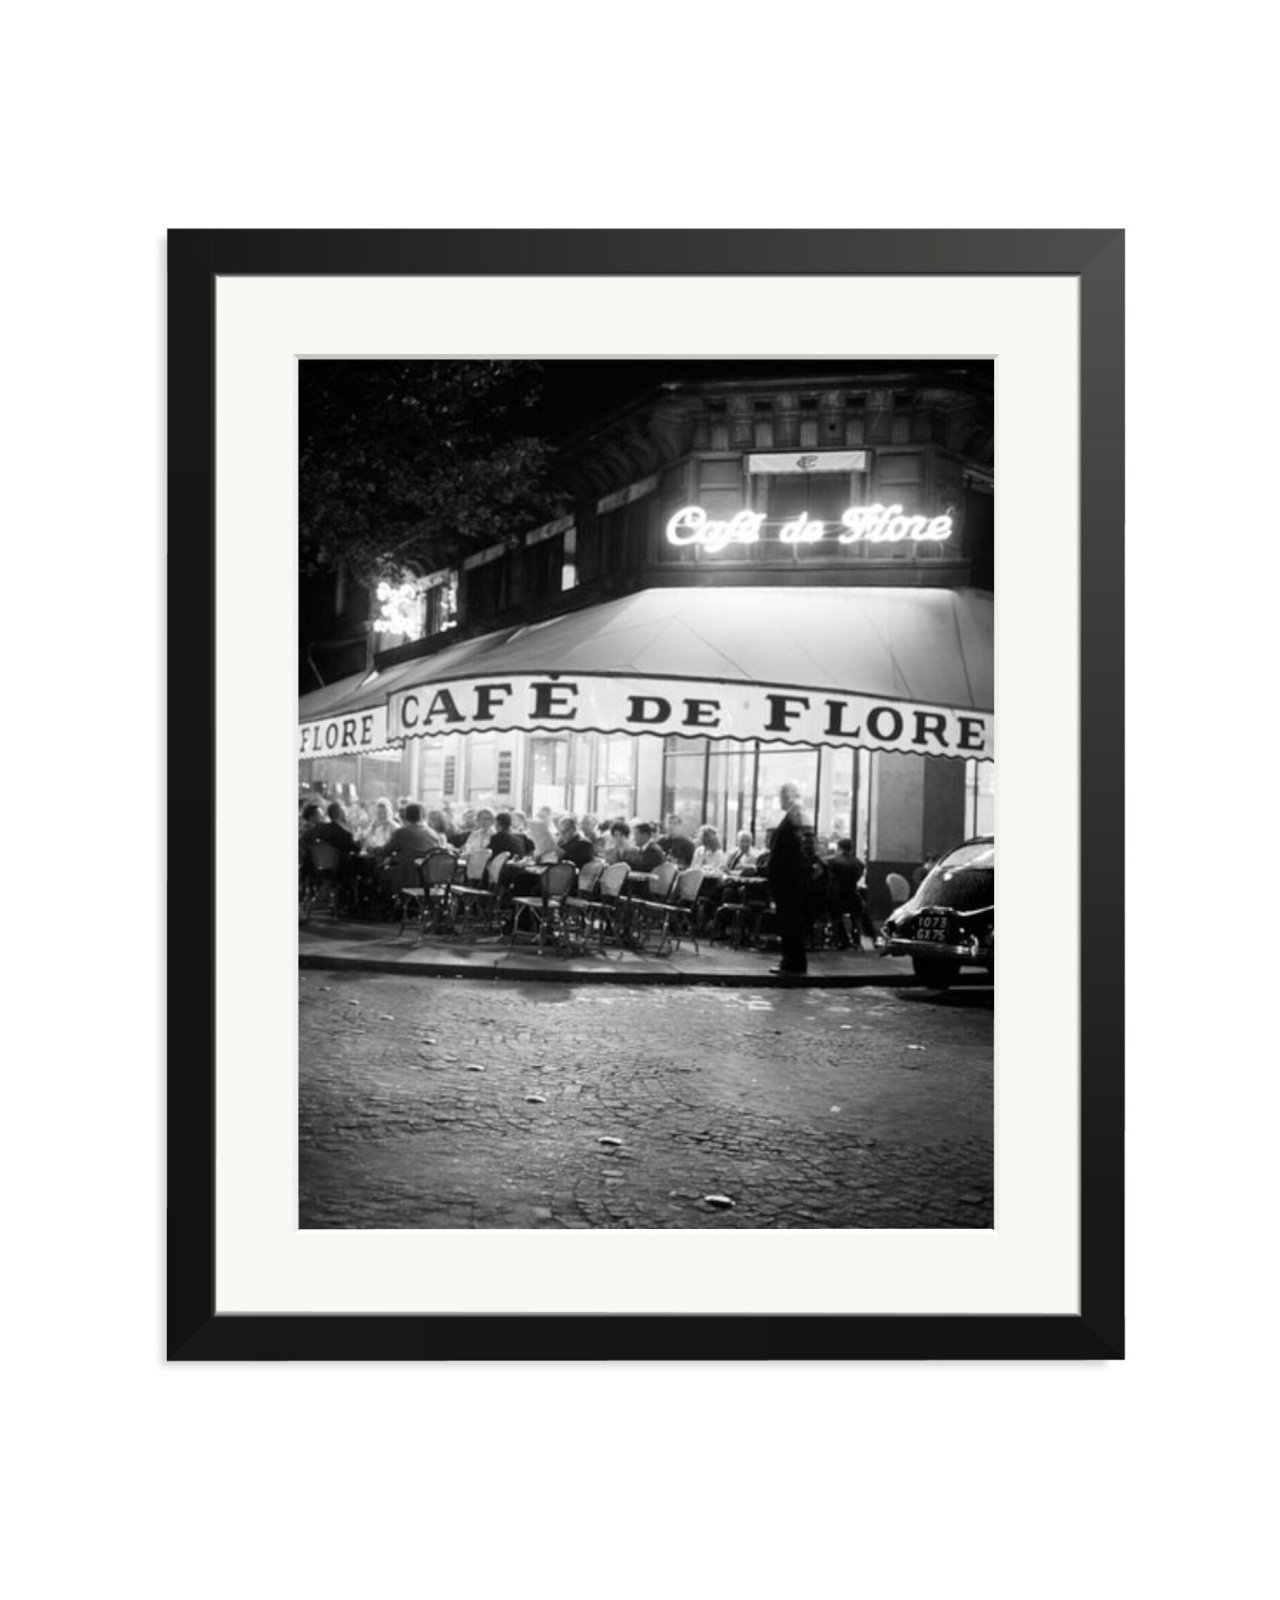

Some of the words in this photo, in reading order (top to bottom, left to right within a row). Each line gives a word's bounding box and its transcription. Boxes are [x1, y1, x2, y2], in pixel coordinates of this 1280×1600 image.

[779, 512, 824, 543] de
[839, 503, 955, 543] Flore
[300, 714, 374, 752] FLORE
[626, 694, 722, 727] DE
[765, 693, 986, 751] FLORE
